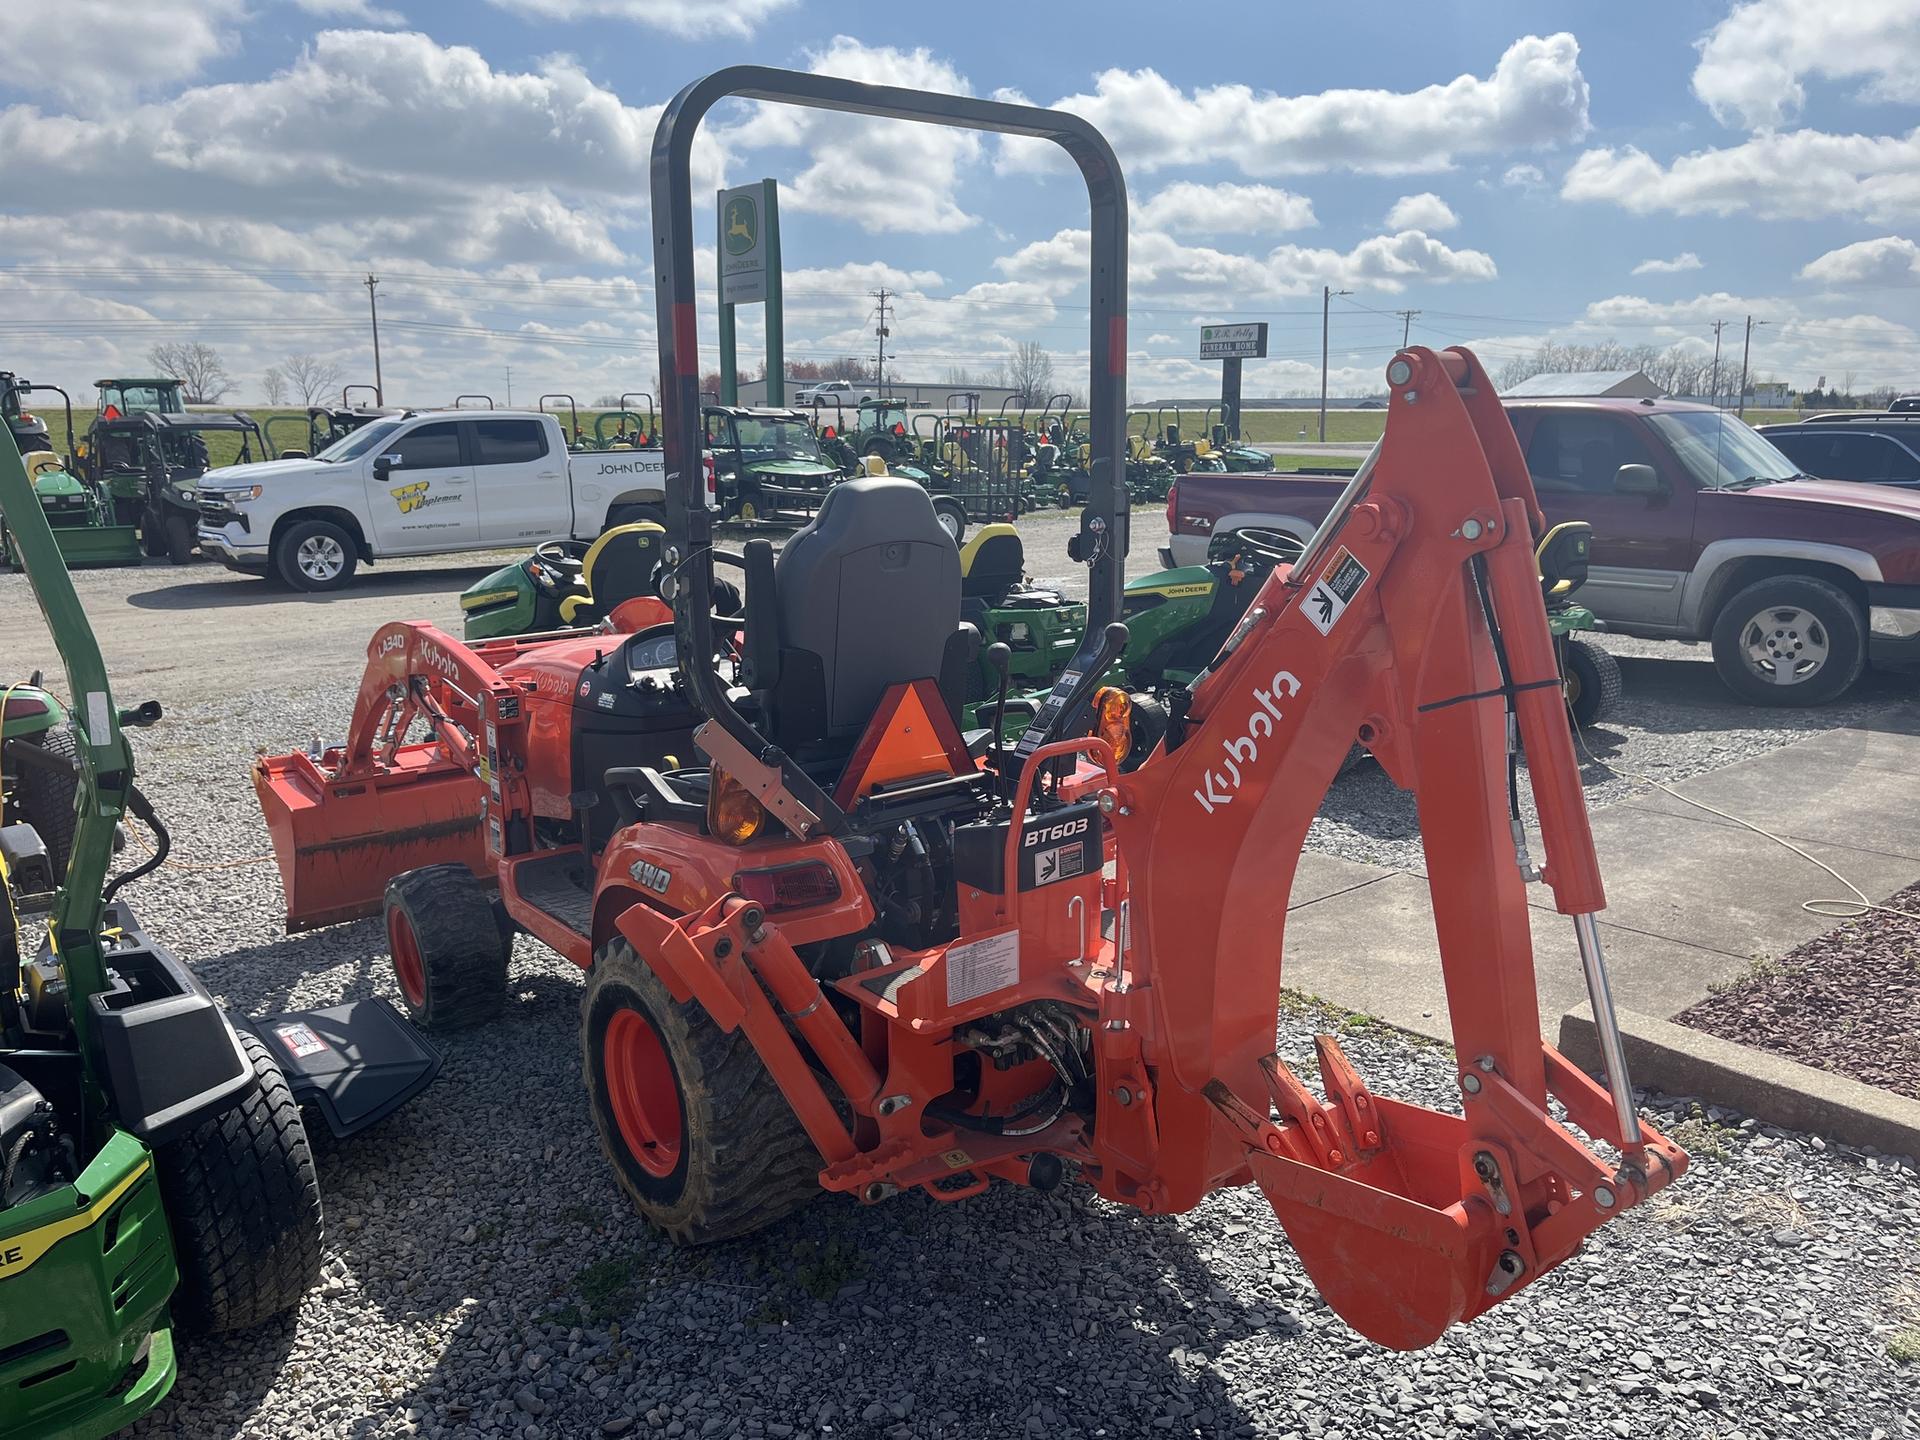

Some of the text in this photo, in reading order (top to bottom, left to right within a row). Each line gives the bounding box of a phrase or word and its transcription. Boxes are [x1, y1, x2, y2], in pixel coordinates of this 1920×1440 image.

[1202, 341, 1257, 353] FUNERAL HOME
[597, 461, 665, 475] JOHN DEE
[378, 634, 404, 659] LA340
[420, 639, 460, 681] Kubota
[535, 671, 569, 695] Kubota
[1193, 671, 1301, 814] Kubota
[1024, 818, 1088, 848] BT603
[629, 859, 671, 894] 4WD
